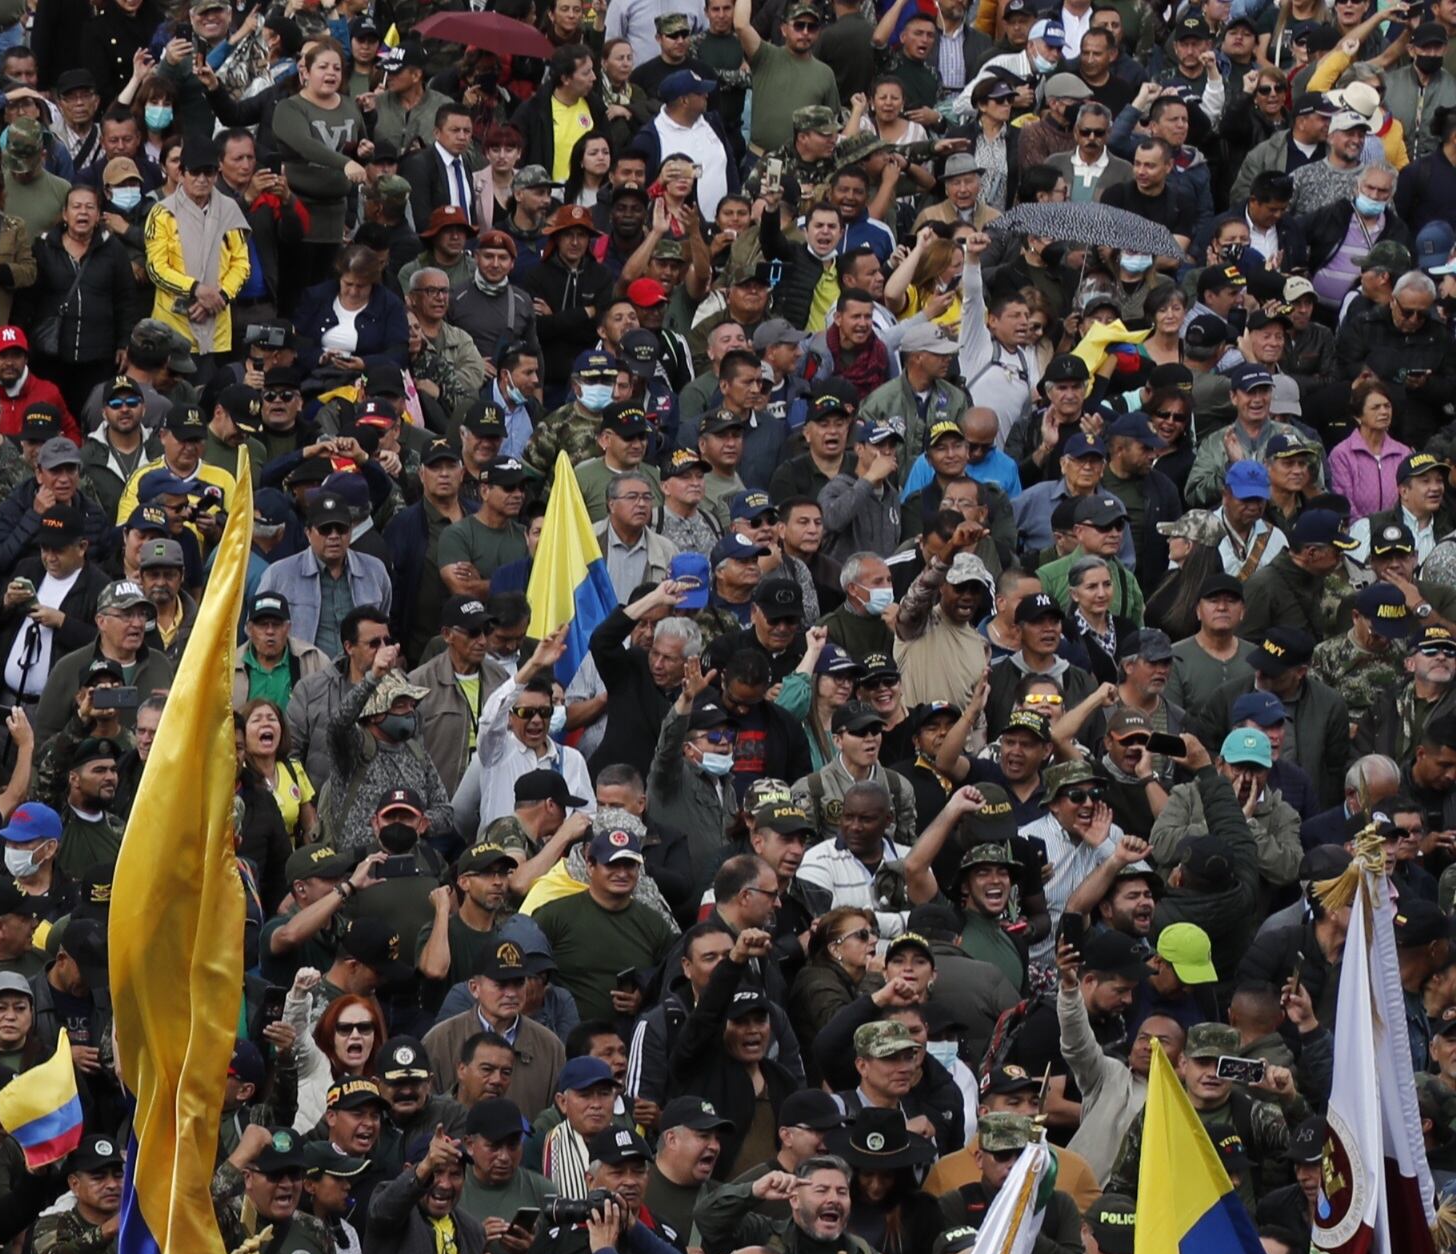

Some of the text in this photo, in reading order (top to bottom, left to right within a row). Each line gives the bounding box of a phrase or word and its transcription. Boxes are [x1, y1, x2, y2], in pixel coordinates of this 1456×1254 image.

[977, 802, 1012, 814] OLICIA
[1100, 1211, 1136, 1225] POLIC
[945, 1225, 979, 1242] POLI
